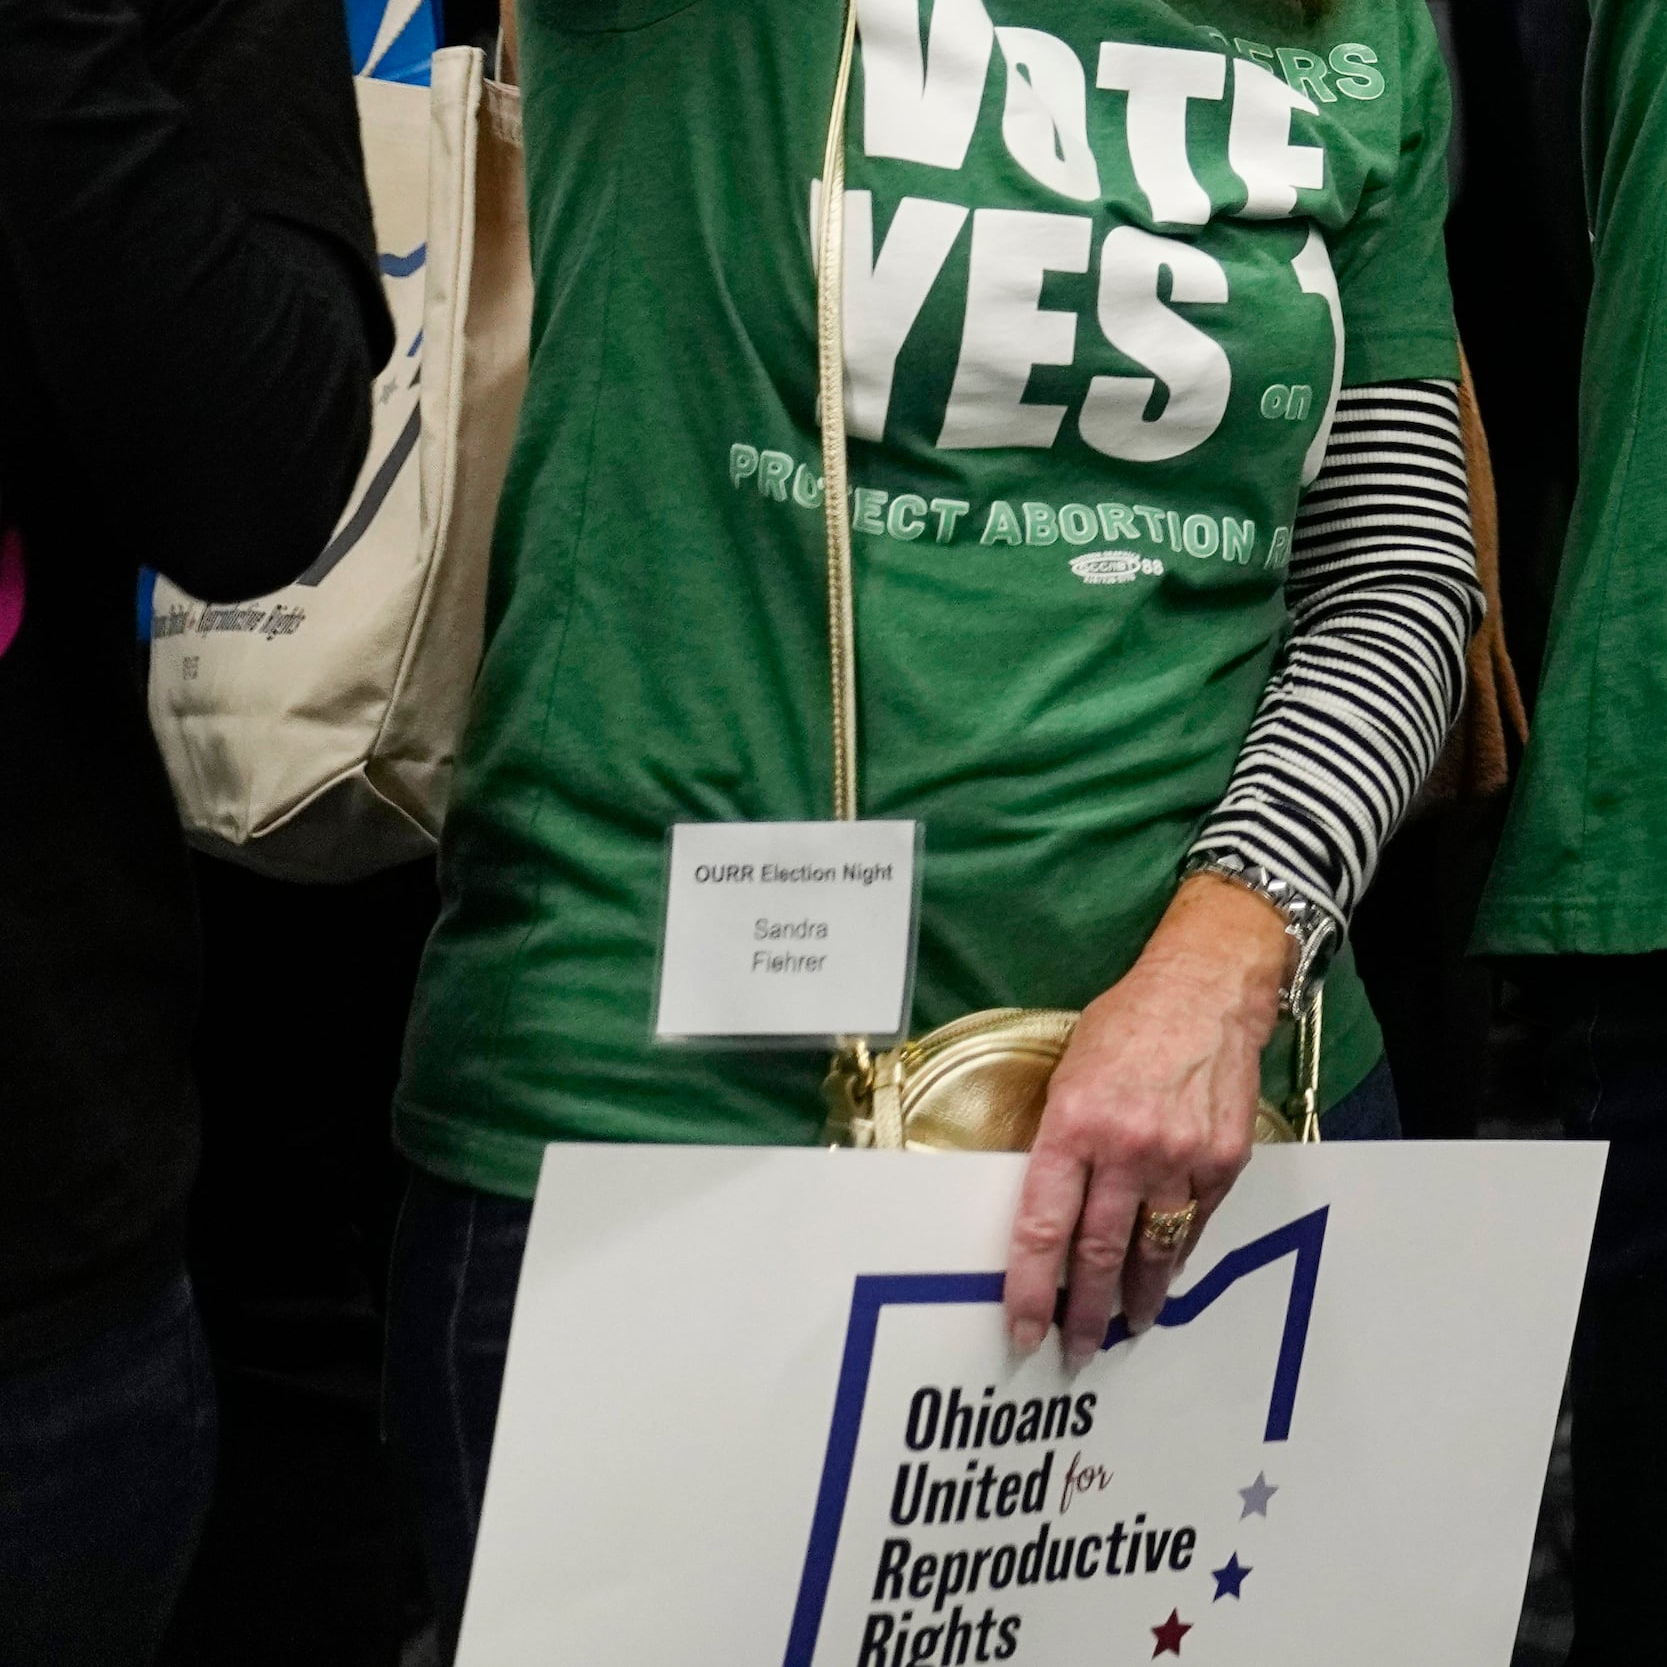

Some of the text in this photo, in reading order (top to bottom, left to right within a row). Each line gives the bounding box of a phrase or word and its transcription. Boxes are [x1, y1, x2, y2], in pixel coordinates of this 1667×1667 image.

[811, 178, 1234, 463] YES
[1260, 384, 1313, 421] on
[729, 443, 971, 544] PROECT
[979, 499, 1256, 565] ABORTION
[694, 861, 894, 886] OURR Election Night
[751, 949, 828, 973] Fiehrer
[753, 917, 829, 940] Sandra
[905, 1386, 1097, 1452] Ohioans
[889, 1450, 1115, 1526] United for
[871, 1513, 1197, 1613] Reproductive
[857, 1605, 1023, 1667] Rights
